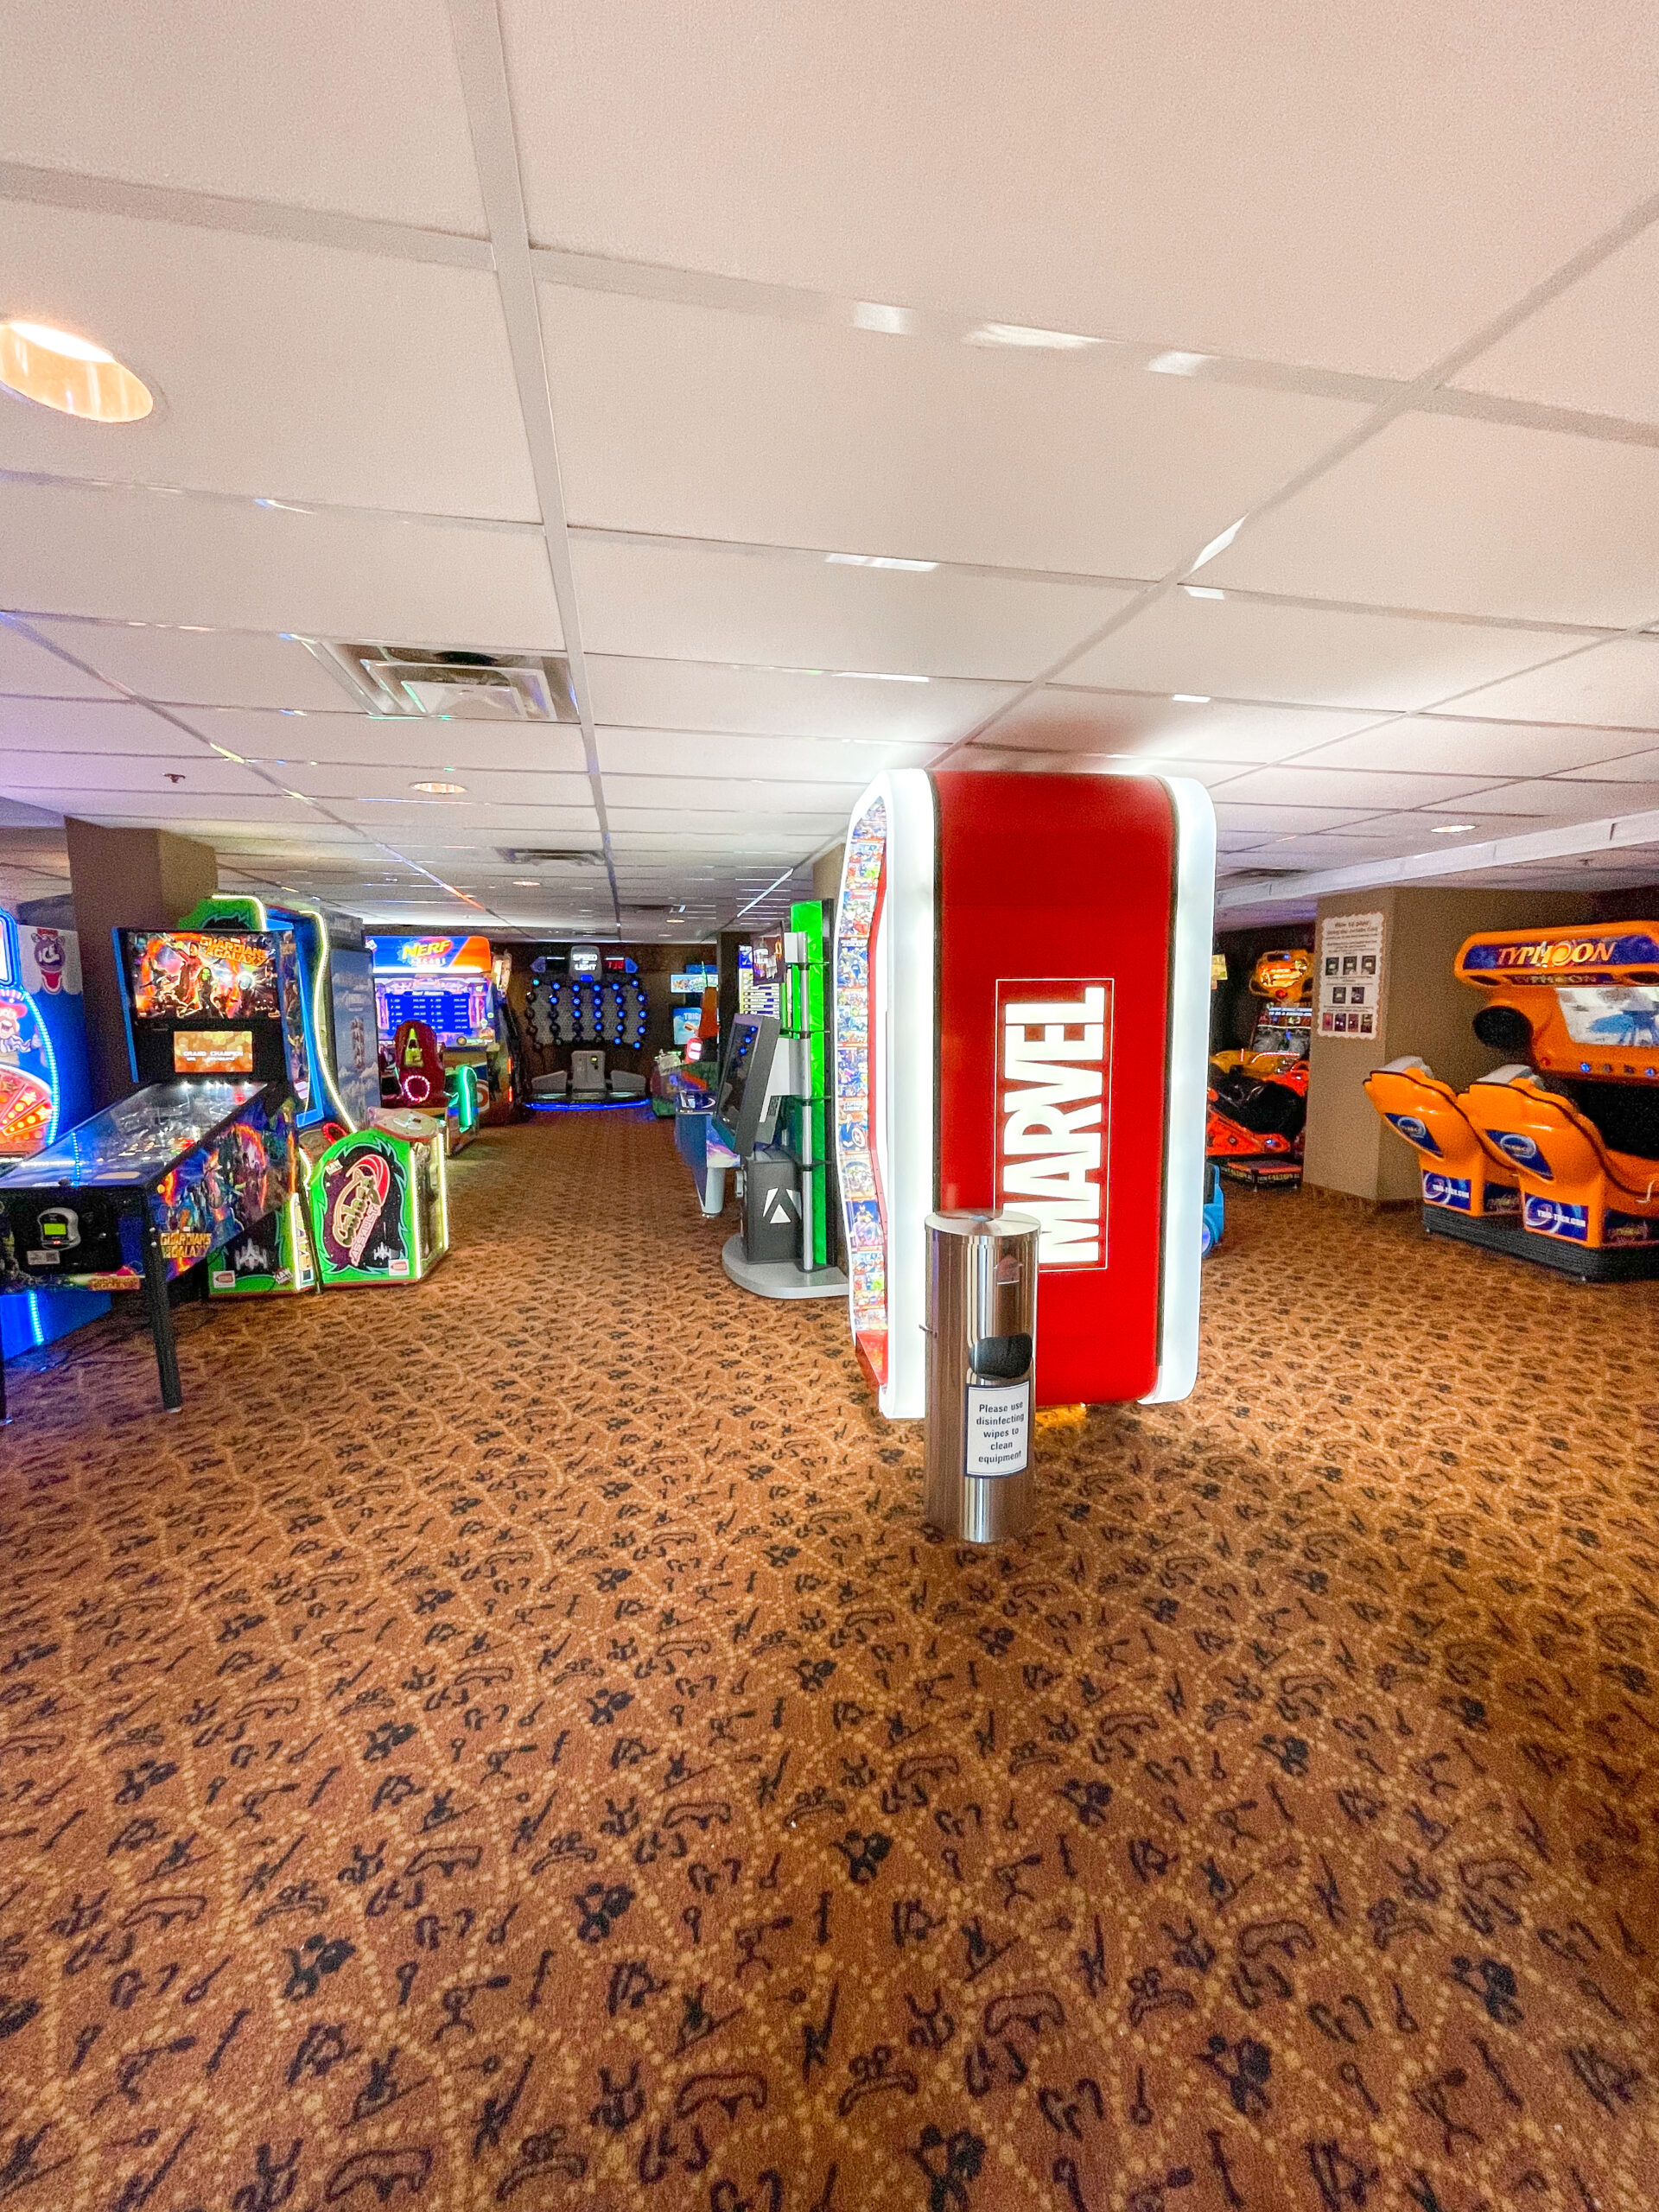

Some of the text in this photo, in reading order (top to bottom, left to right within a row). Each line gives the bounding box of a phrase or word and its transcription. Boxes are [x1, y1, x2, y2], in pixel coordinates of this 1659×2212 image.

[402, 939, 452, 960] NERF
[1497, 940, 1618, 967] TYPHOON
[1003, 987, 1105, 1263] MARVEL
[161, 1231, 213, 1247] GUARDIANS
[979, 1402, 1023, 1413] Please use
[976, 1414, 1025, 1426] disinfecting
[983, 1430, 1009, 1440] wipes
[990, 1441, 1013, 1451] clean
[978, 1451, 1021, 1465] equipment
